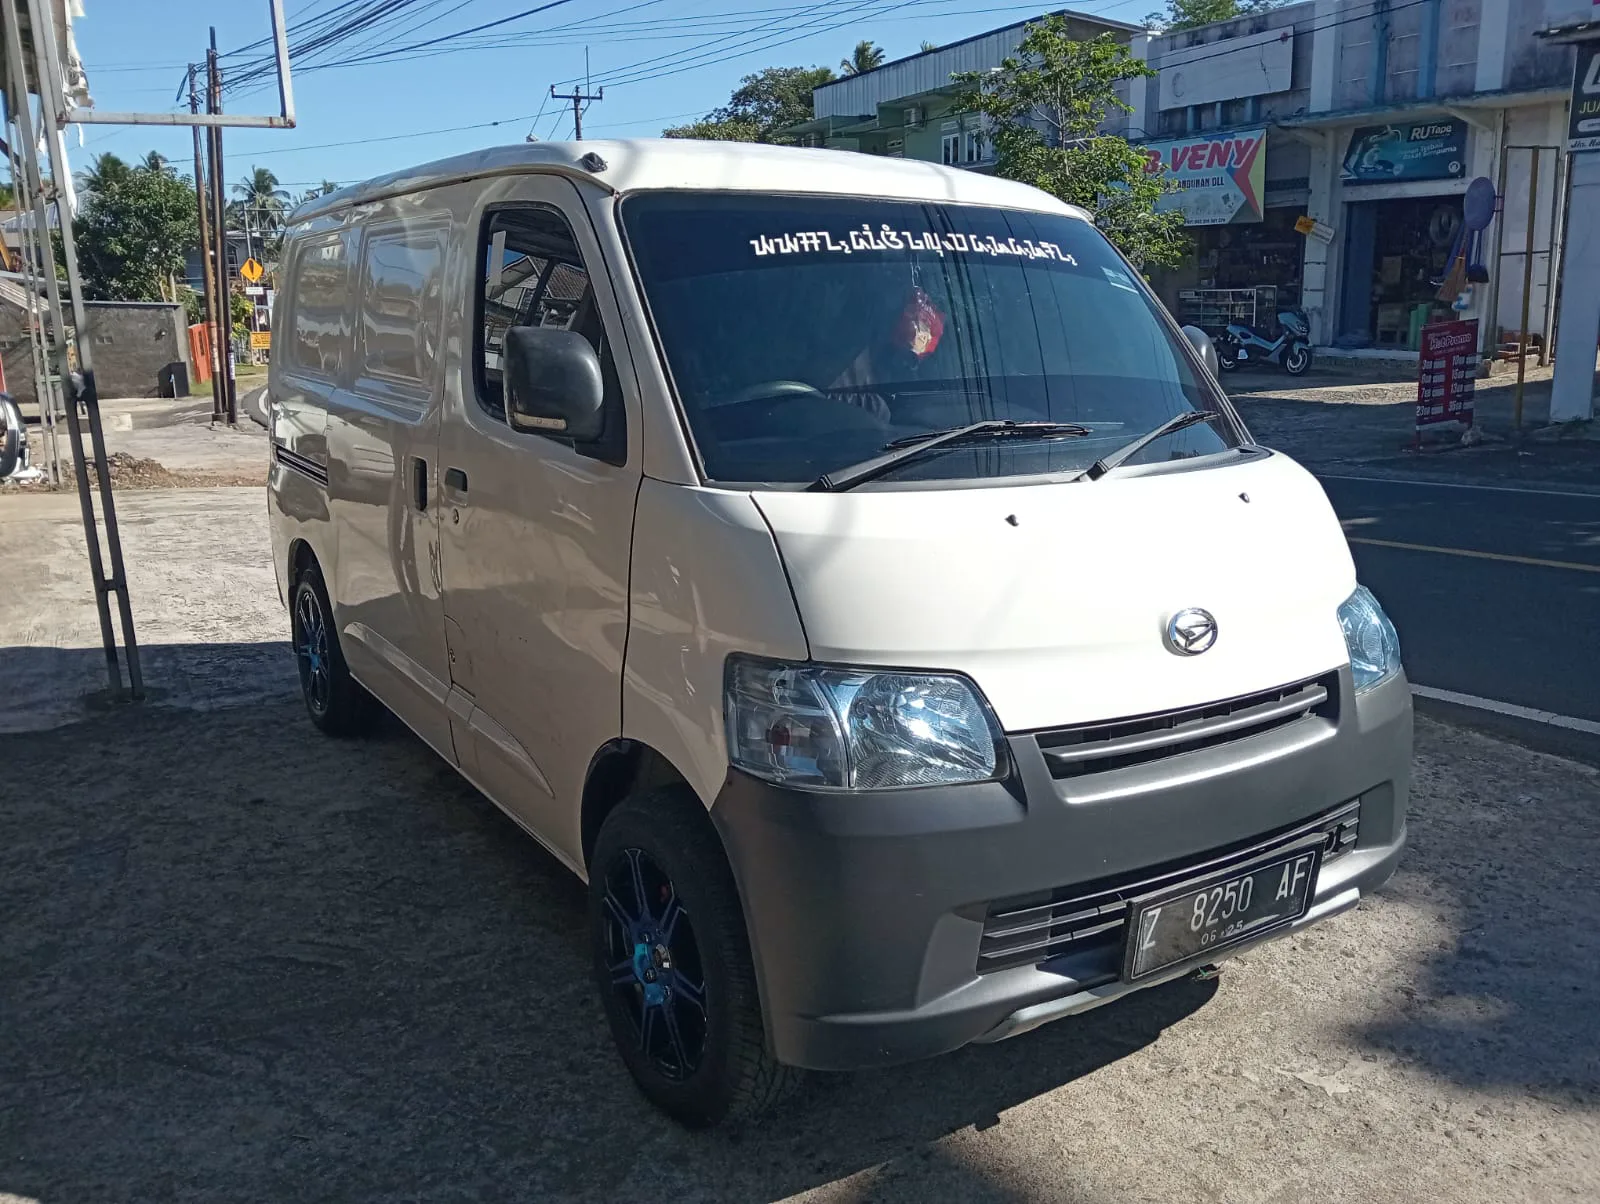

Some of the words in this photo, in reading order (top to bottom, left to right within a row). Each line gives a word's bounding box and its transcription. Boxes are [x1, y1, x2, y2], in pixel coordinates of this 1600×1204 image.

[1171, 138, 1254, 172] VENY
[1143, 907, 1162, 951] Z
[1190, 876, 1254, 932] 8250
[1275, 857, 1309, 901] AF
[1201, 929, 1216, 945] 06
